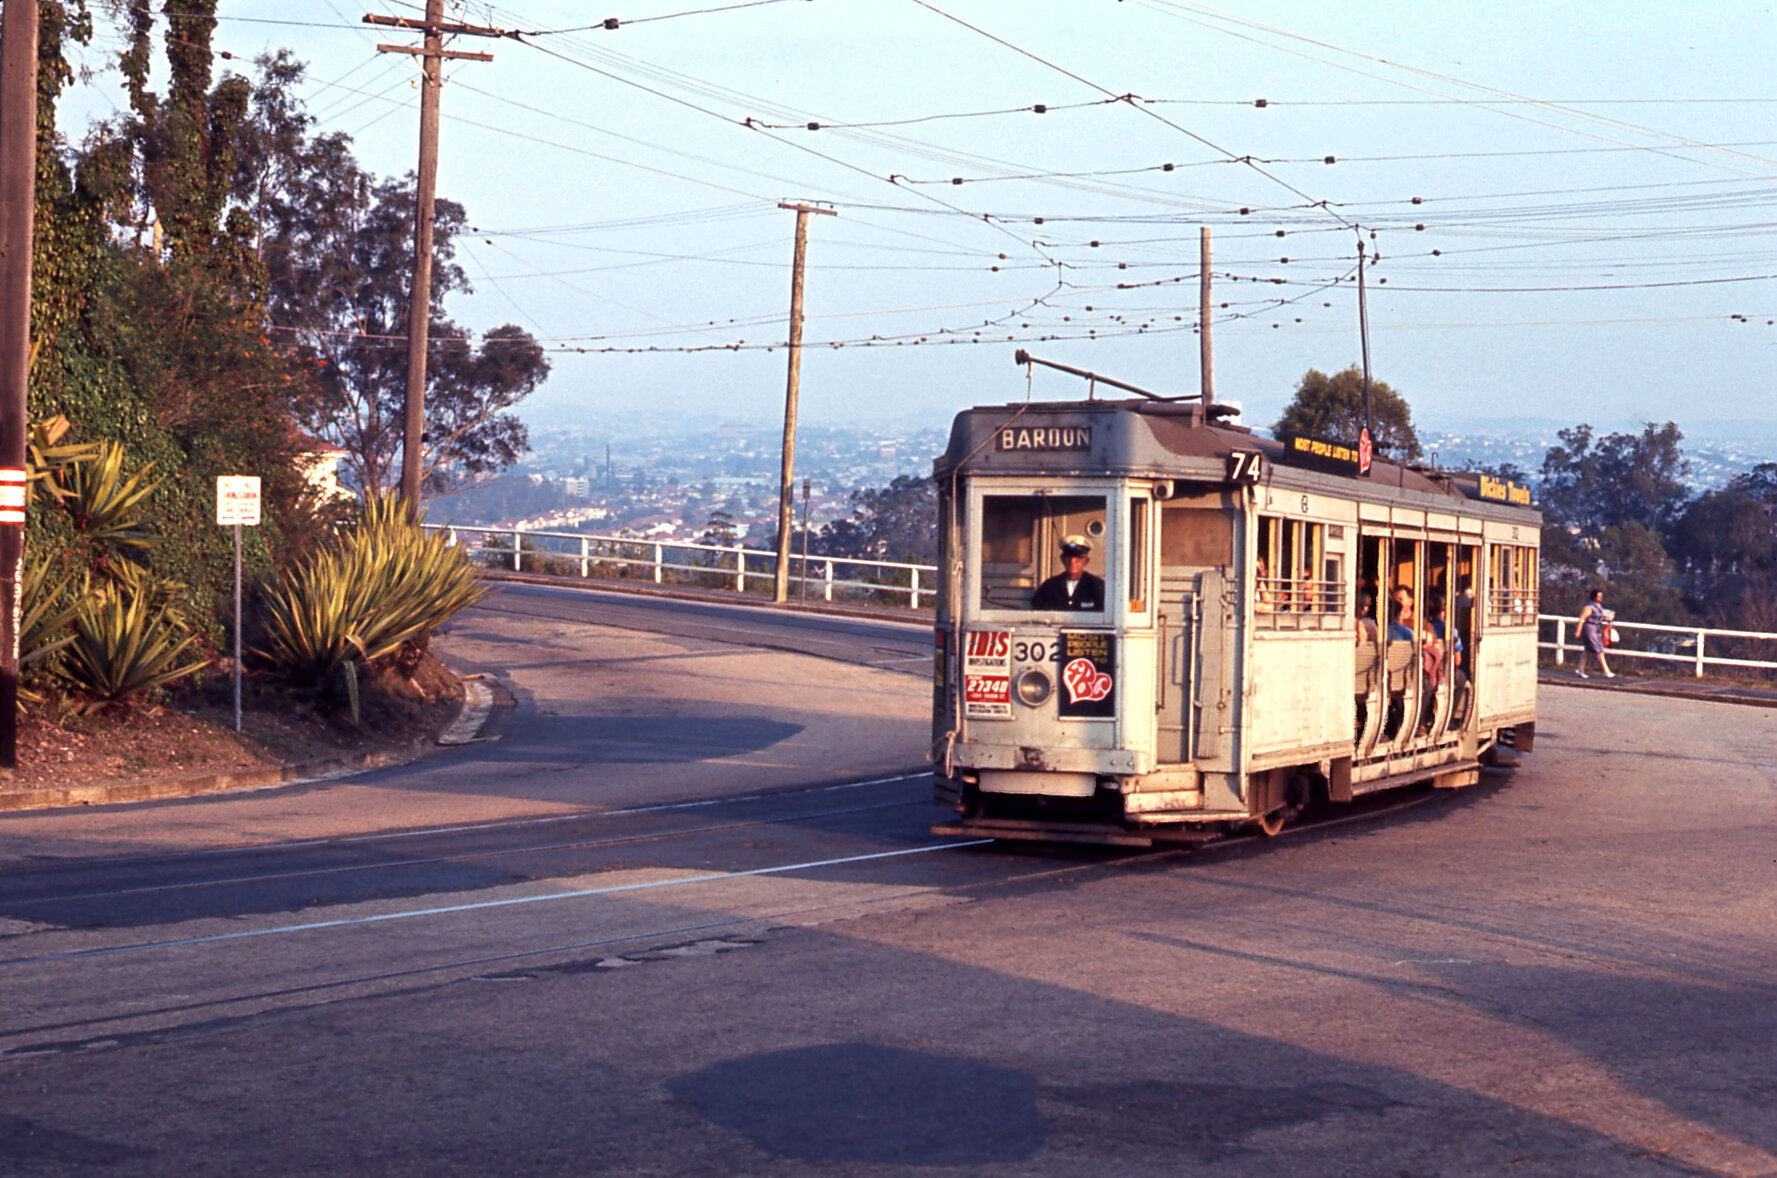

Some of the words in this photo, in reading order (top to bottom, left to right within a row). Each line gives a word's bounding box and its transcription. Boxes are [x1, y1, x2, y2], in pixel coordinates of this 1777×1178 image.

[1002, 428, 1090, 449] BARDON
[1231, 452, 1260, 481] 74
[1014, 641, 1060, 663] 302
